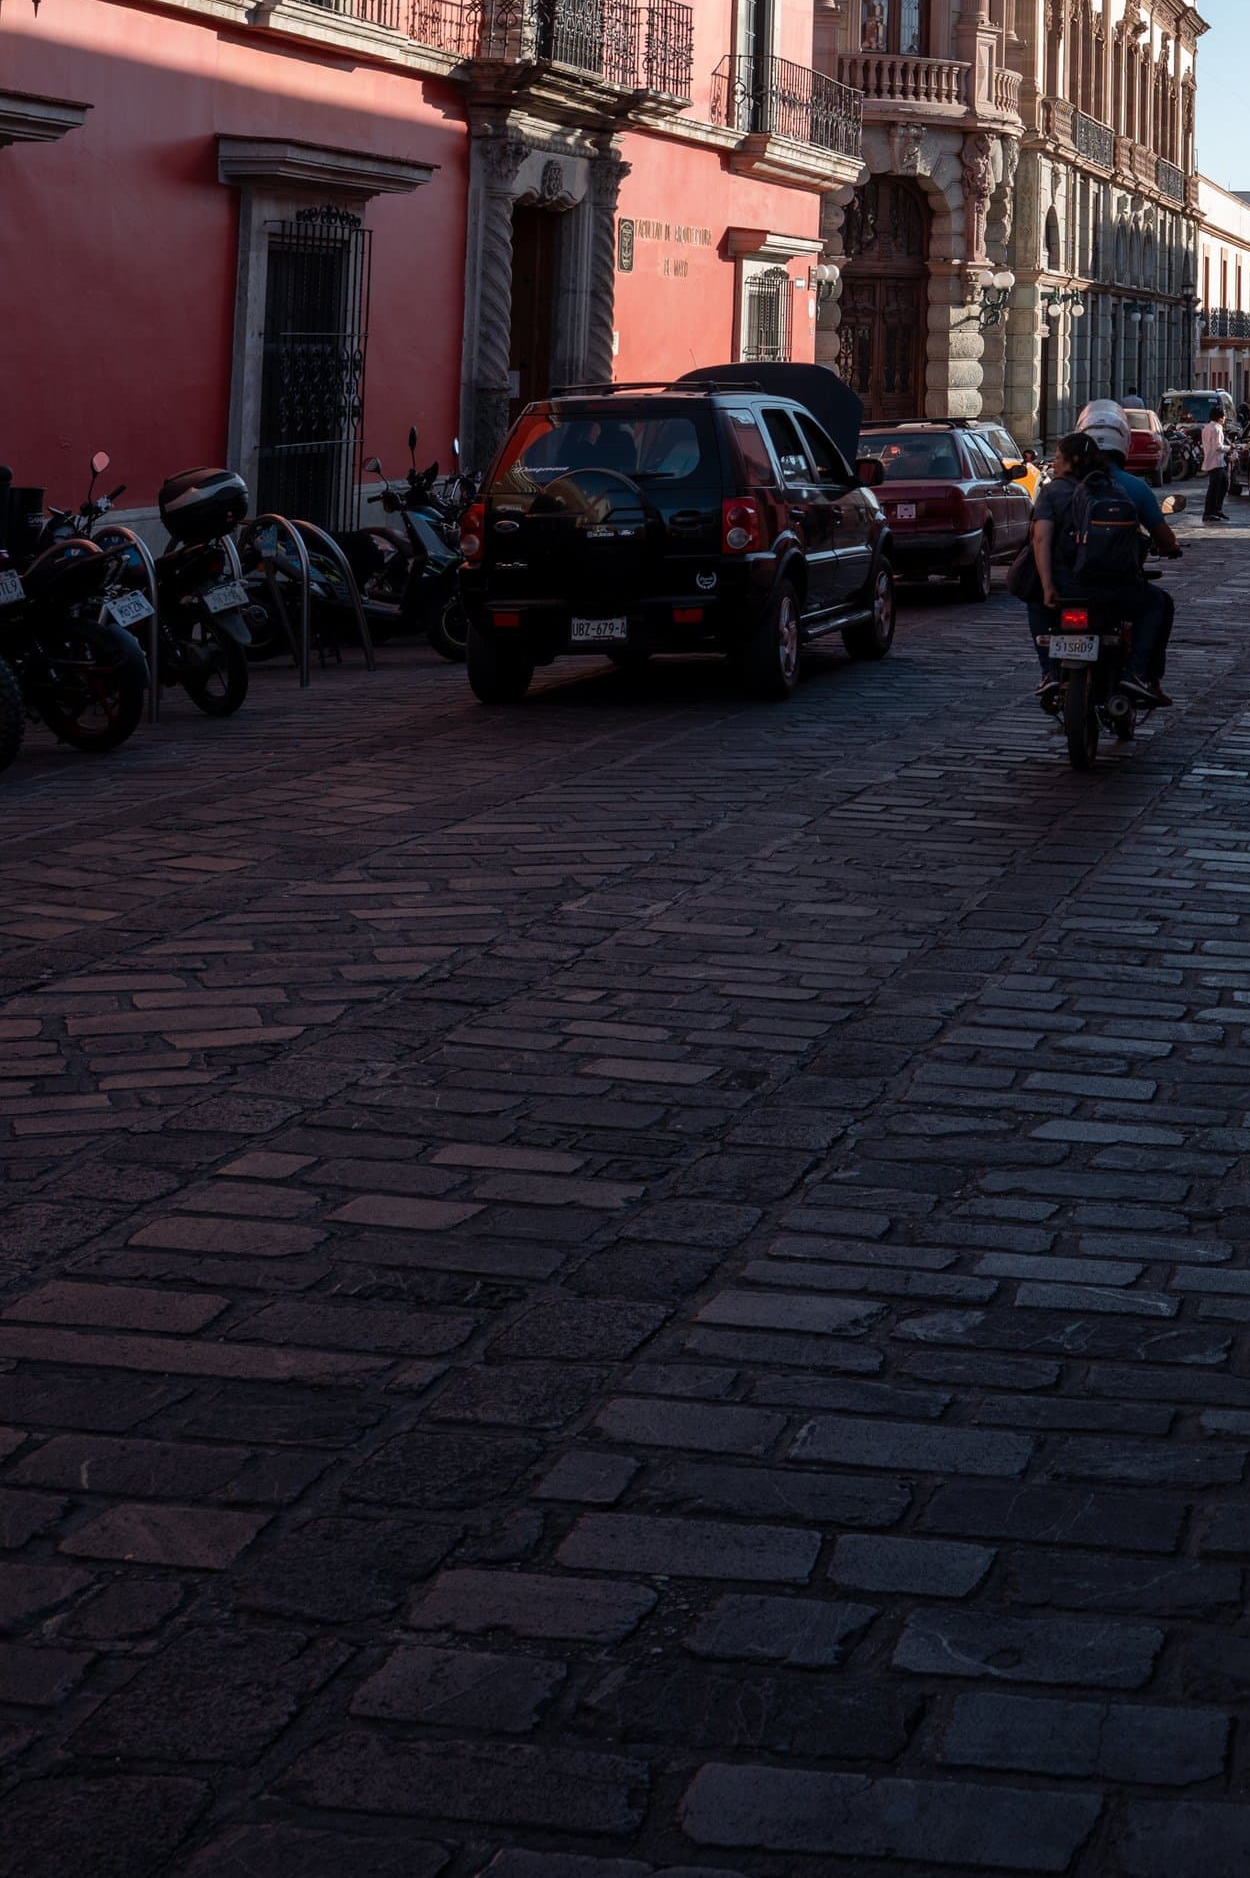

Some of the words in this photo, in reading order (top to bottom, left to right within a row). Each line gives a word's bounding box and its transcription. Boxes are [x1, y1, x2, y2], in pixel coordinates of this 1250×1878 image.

[634, 218, 663, 241] FACULTAD
[573, 622, 626, 636] UBZ-679-A
[1055, 641, 1094, 654] 51SRD9
